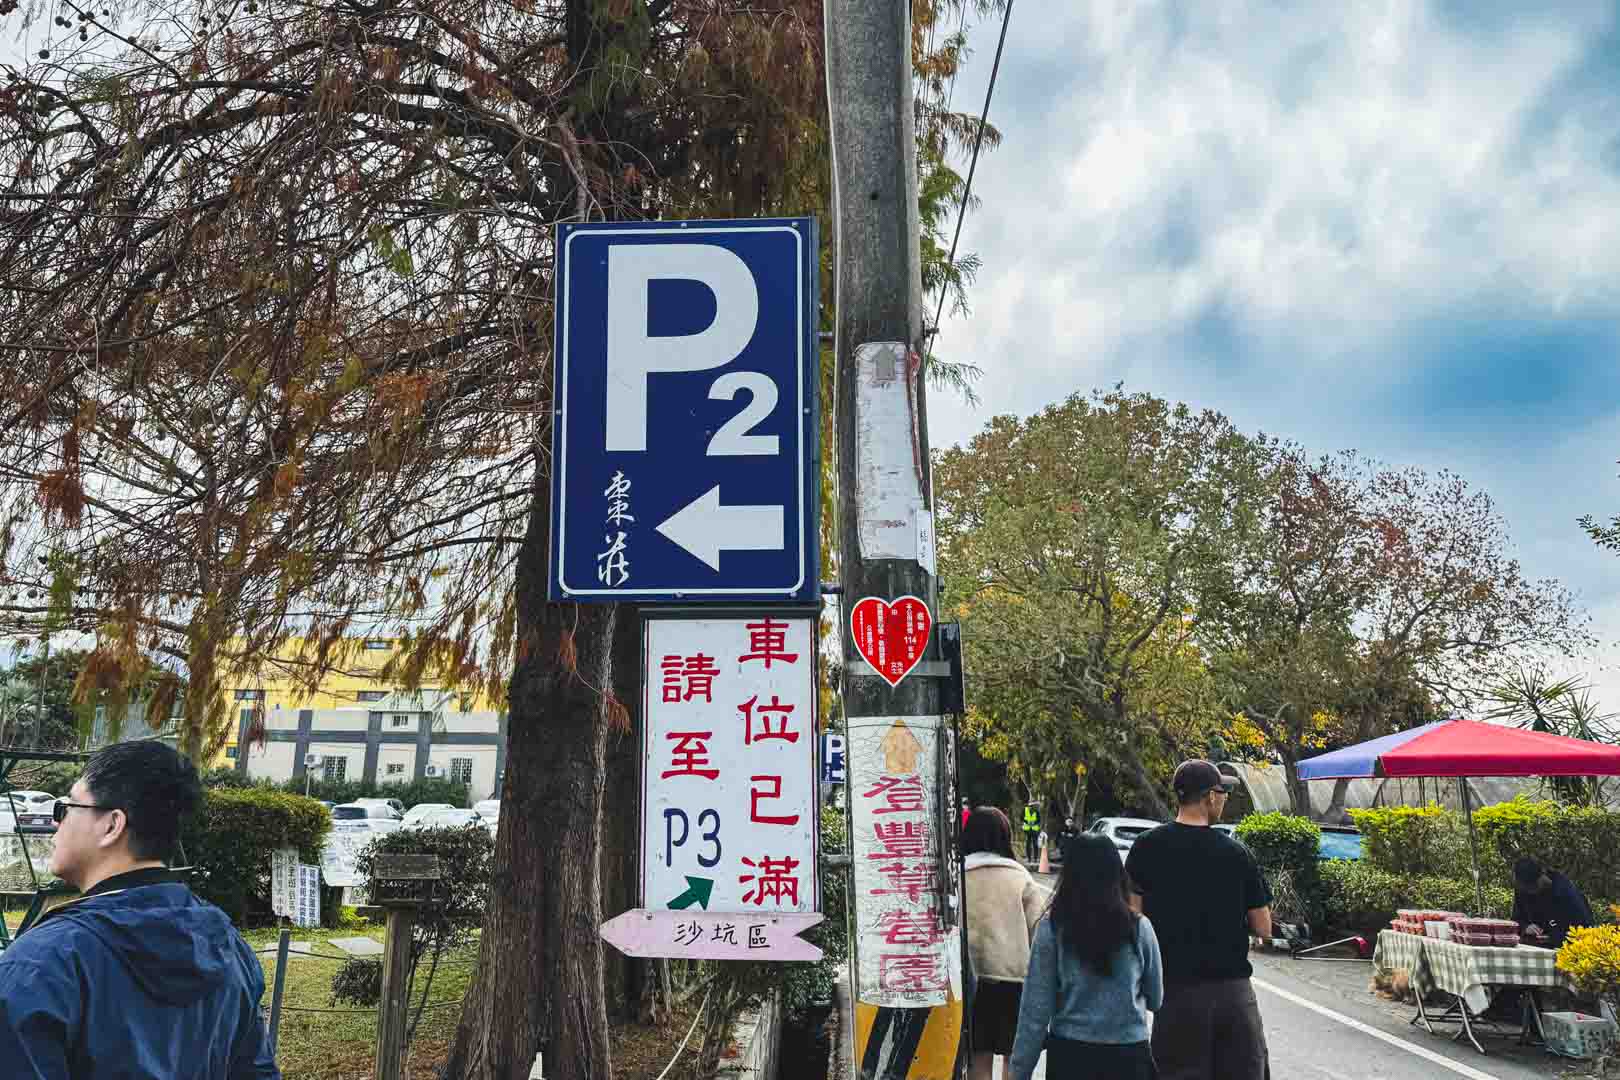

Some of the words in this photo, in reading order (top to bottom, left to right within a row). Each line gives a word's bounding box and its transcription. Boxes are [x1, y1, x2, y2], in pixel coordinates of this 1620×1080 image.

[660, 653, 721, 780] 請至
[738, 617, 800, 906] 車位已滿
[663, 807, 722, 868] P3
[673, 920, 772, 949] 沙坑區
